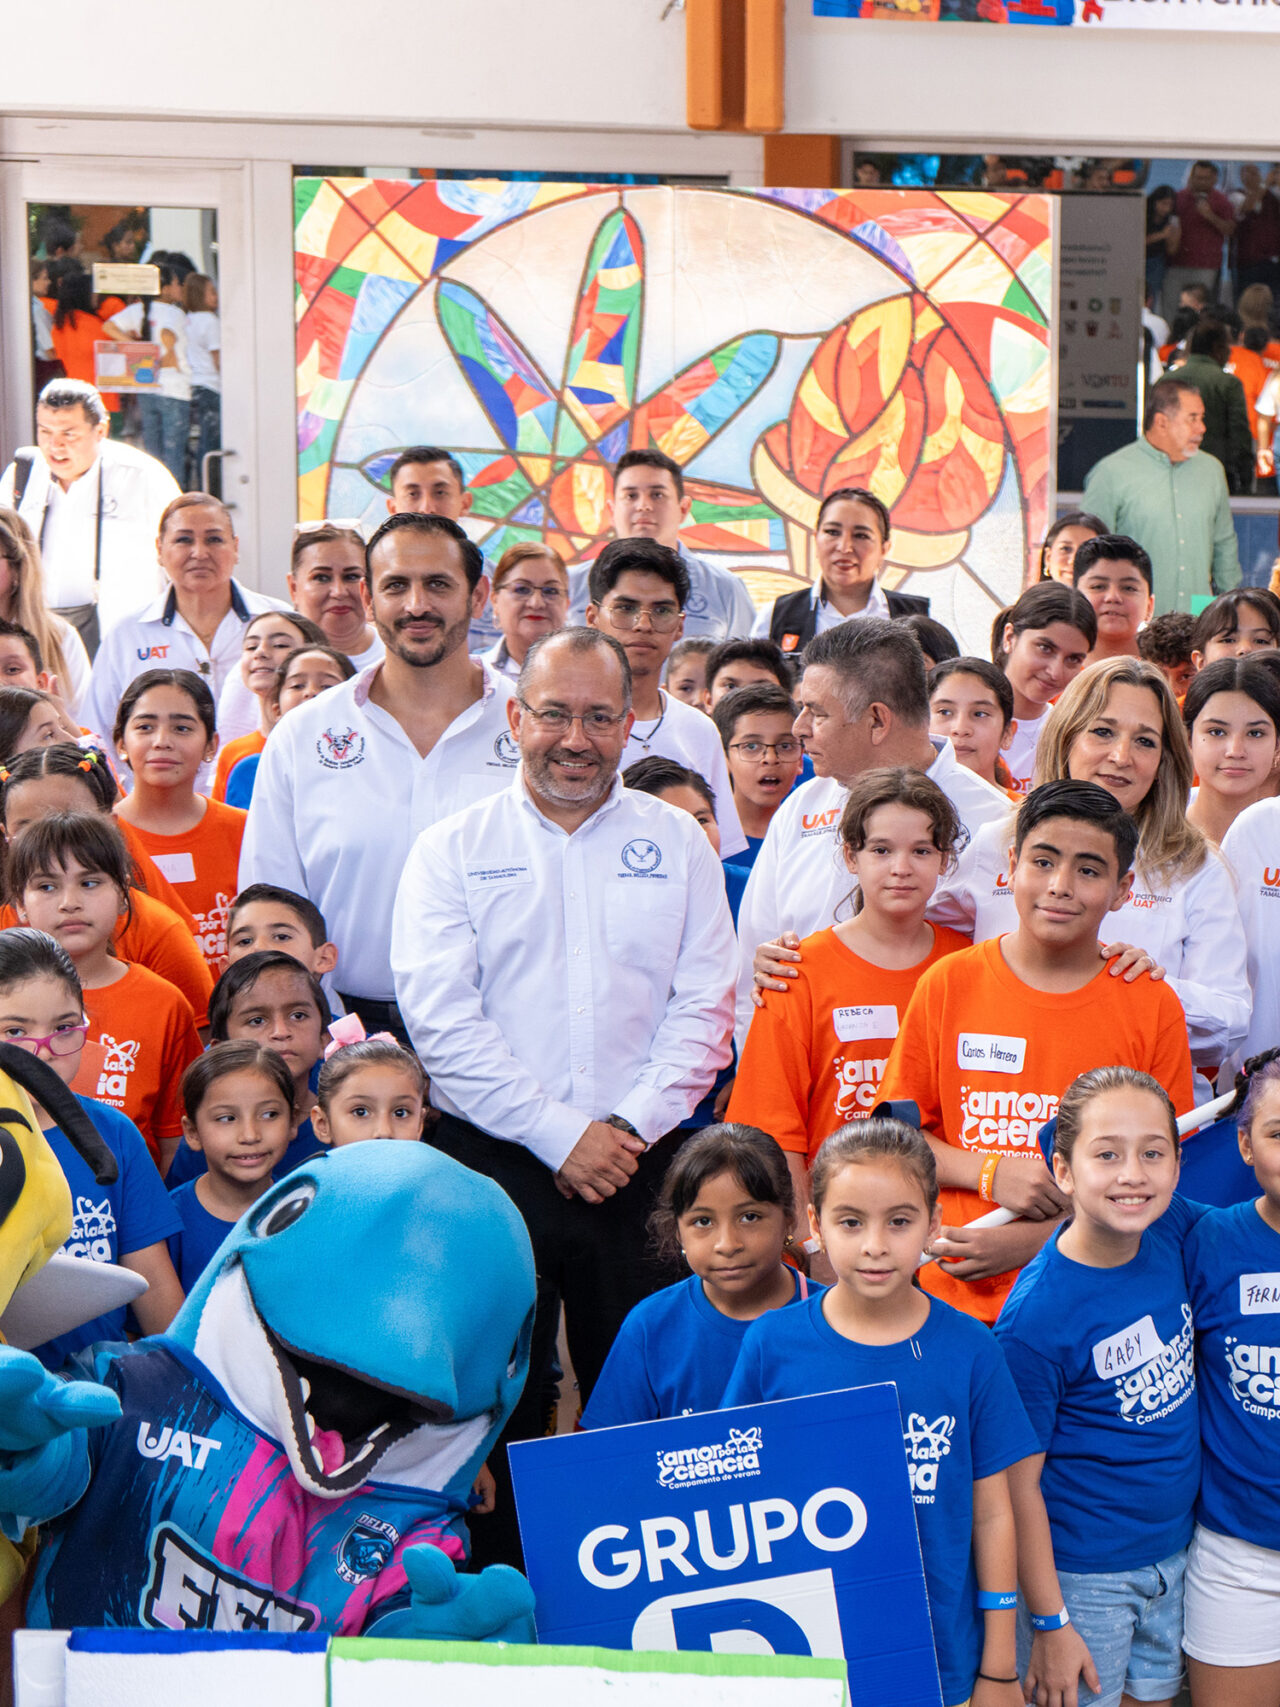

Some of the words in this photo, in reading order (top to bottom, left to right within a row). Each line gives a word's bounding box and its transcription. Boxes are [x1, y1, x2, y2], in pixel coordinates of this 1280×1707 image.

[137, 645, 170, 661] UAT
[802, 808, 841, 830] UAT
[1133, 899, 1156, 909] UAT
[838, 1008, 875, 1018] REBECA
[967, 1091, 1060, 1120] amor
[1104, 1333, 1142, 1372] GABY
[1123, 1335, 1181, 1397] amor
[1136, 1388, 1192, 1425] Campamento
[136, 1421, 222, 1471] UAT
[663, 1444, 723, 1467] amor
[668, 1476, 722, 1490] Campamento
[722, 1473, 733, 1482] de
[733, 1469, 762, 1480] verano
[673, 1453, 760, 1481] ciencia
[577, 1487, 868, 1590] GRUPO
